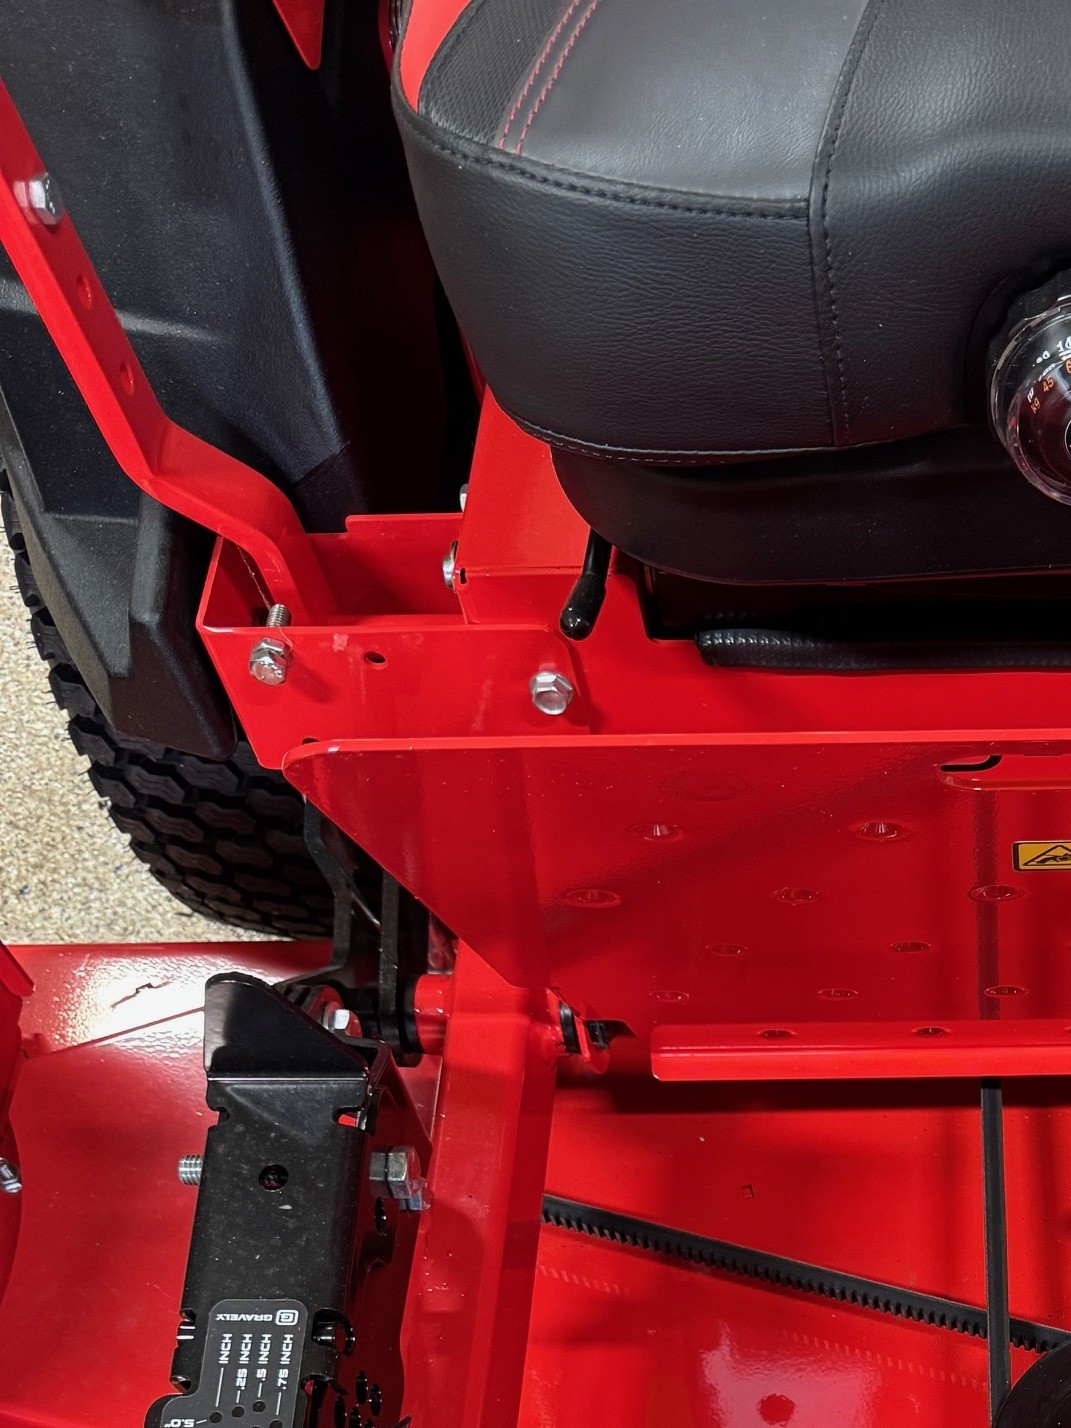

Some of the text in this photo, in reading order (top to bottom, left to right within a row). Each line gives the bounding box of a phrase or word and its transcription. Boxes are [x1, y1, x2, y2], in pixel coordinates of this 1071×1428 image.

[1043, 375, 1054, 392] 45
[215, 1313, 273, 1322] GRAVELY
[218, 1333, 233, 1364] INCH
[236, 1333, 253, 1390] .25 INCH
[256, 1333, 272, 1381] .5 INCH
[277, 1334, 294, 1390] .75 INCH
[163, 1418, 195, 1428] 5.0"
